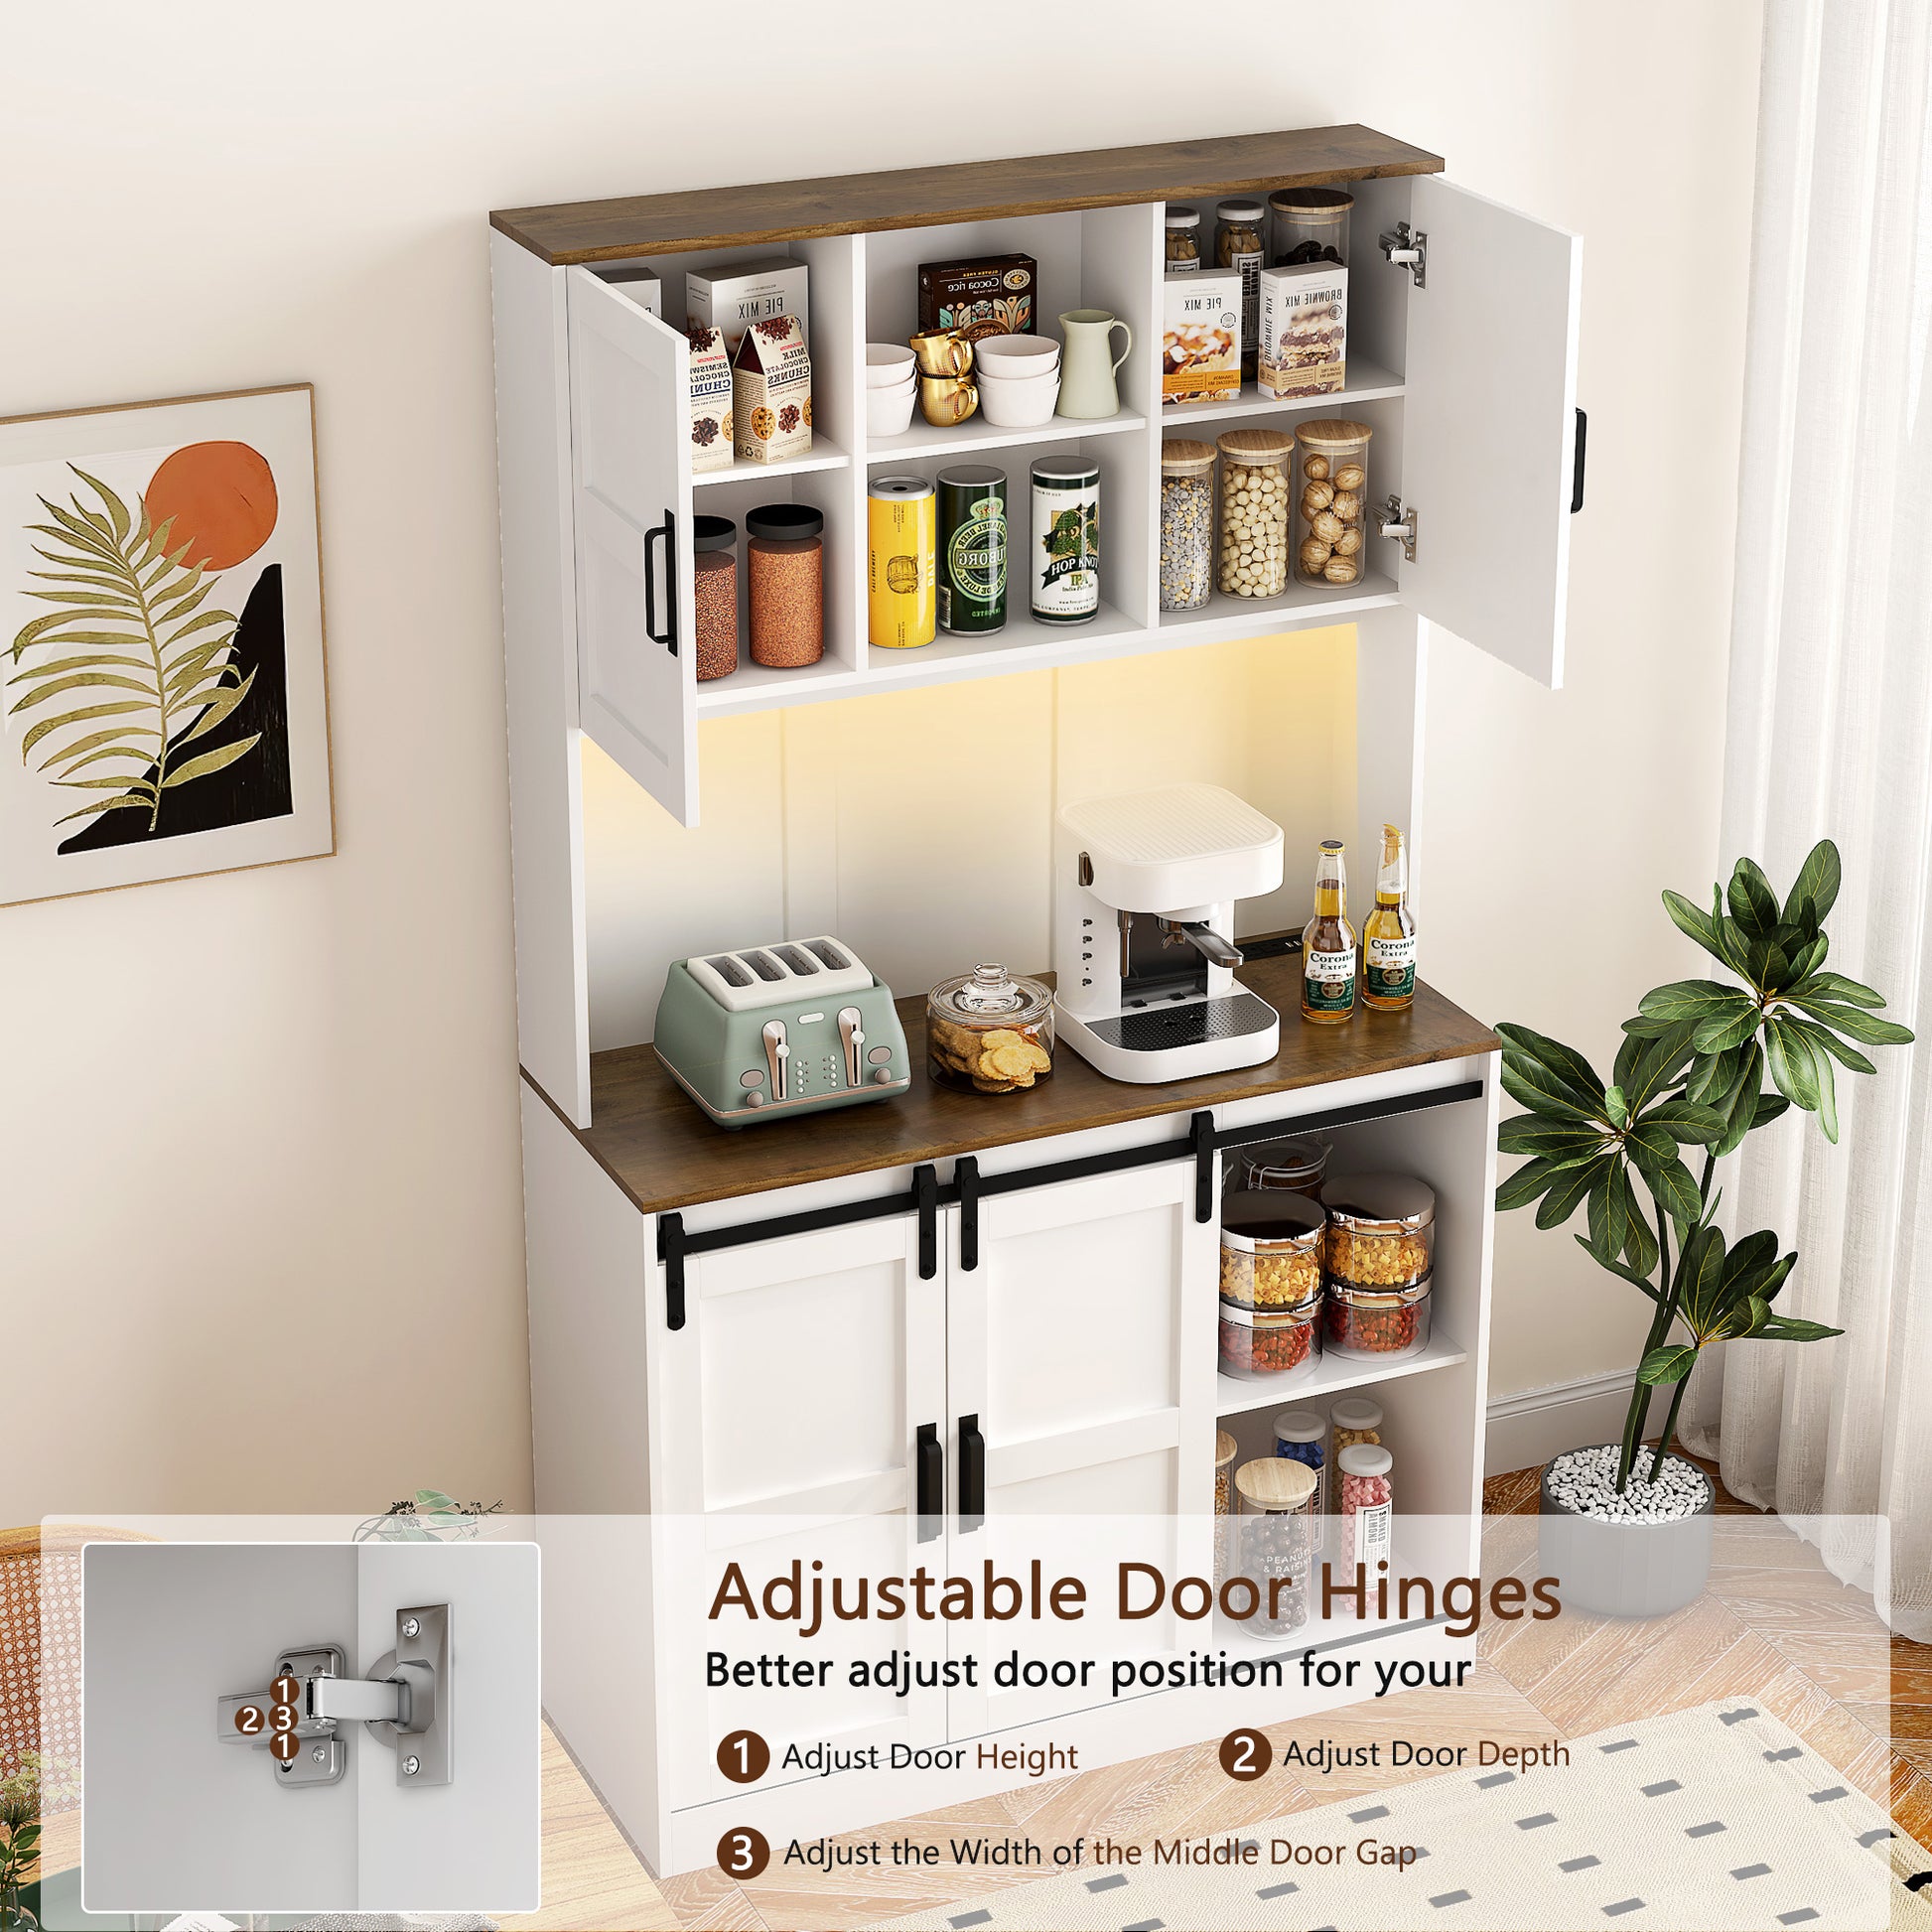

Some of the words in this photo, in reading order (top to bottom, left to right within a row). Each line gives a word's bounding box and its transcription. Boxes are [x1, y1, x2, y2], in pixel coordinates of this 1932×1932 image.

[1050, 558, 1076, 576] HOP
[1070, 574, 1088, 586] IPA
[1370, 939, 1415, 950] Corona
[1310, 952, 1354, 963] Corona
[1319, 962, 1347, 971] Extra
[1263, 1565, 1270, 1574] &
